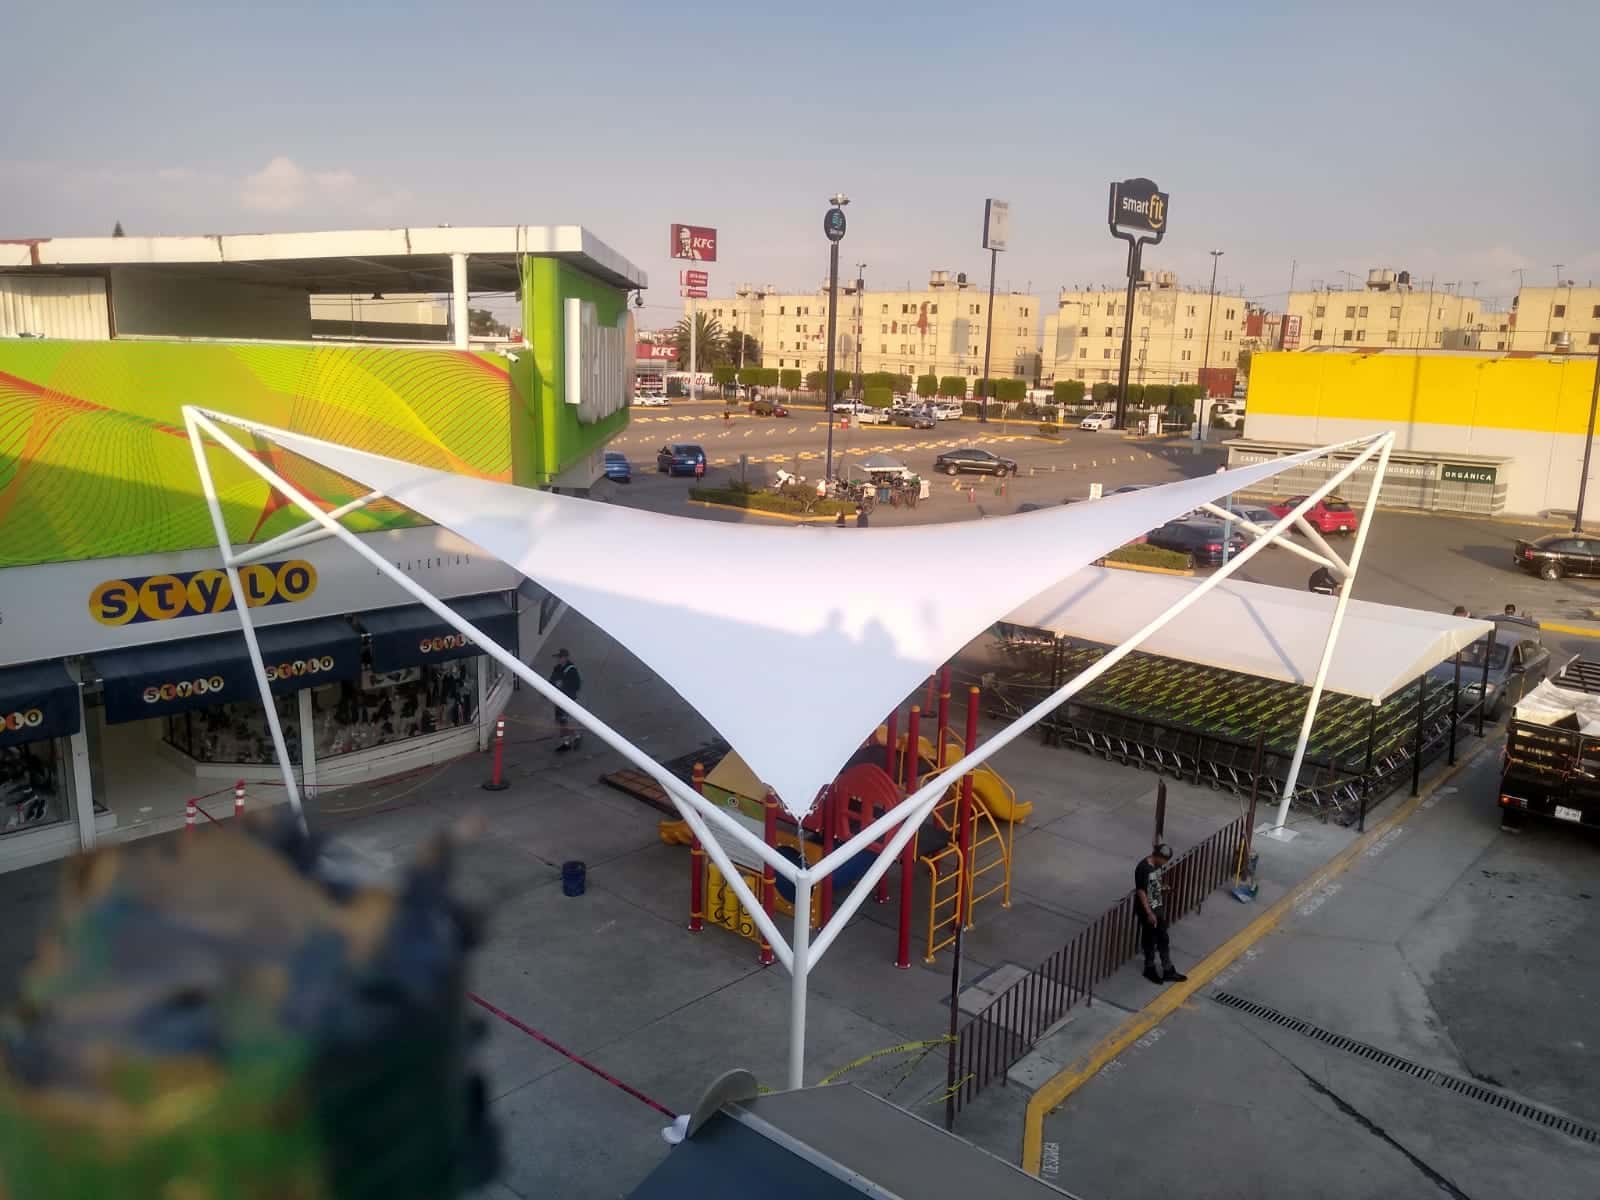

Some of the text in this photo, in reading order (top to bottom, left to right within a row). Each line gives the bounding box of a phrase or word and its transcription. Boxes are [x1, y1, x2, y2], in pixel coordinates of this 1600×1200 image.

[1122, 194, 1164, 220] smart fit
[693, 236, 714, 249] KFC
[651, 346, 677, 357] KFC
[1445, 470, 1492, 481] ORGÁNICA
[144, 677, 223, 702] STYLO
